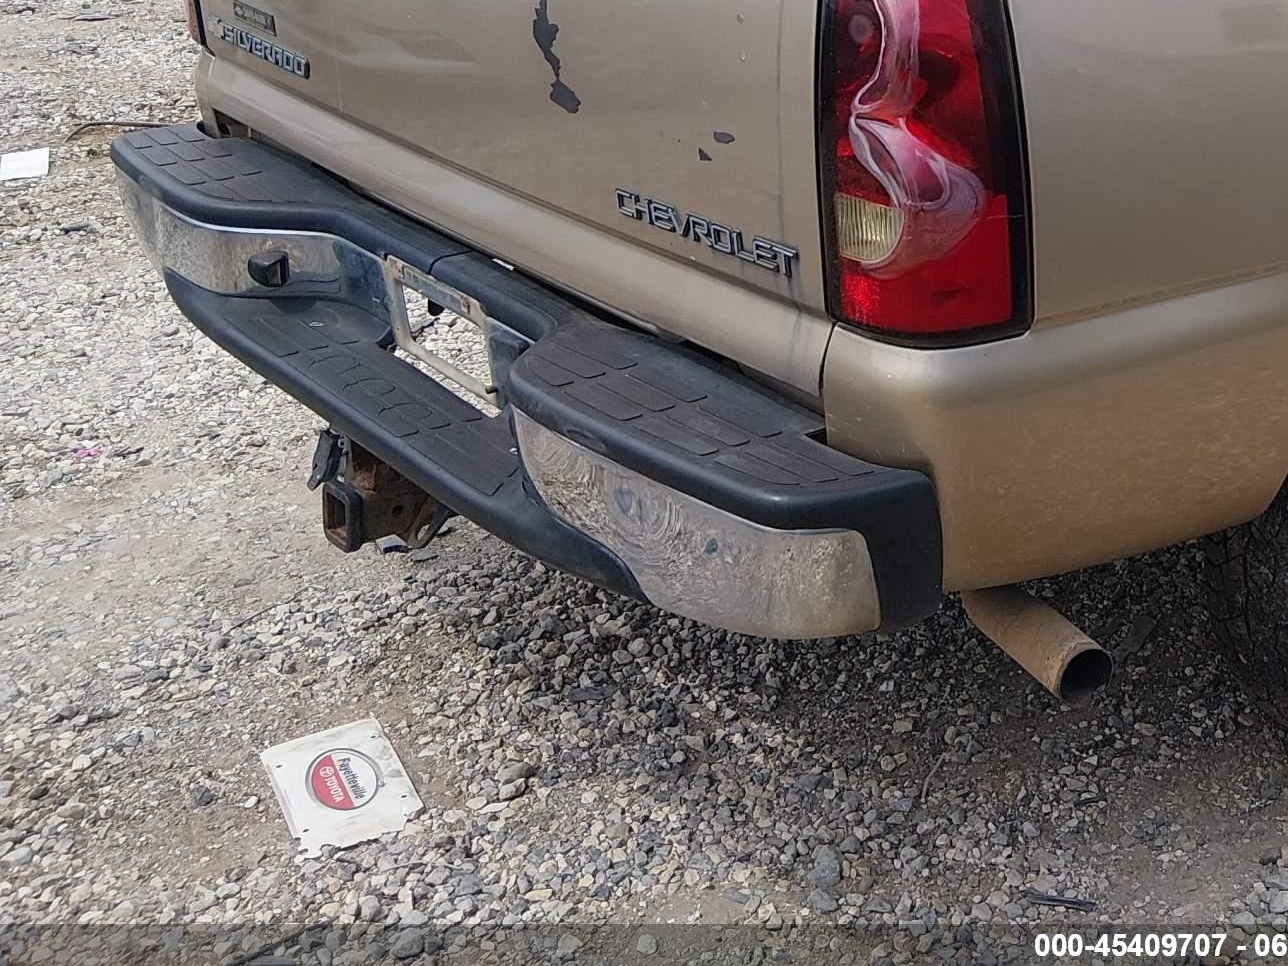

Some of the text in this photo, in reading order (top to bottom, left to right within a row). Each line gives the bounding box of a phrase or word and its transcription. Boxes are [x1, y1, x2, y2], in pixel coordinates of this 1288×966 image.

[223, 24, 306, 77] SILVERADO
[615, 187, 799, 277] CHEVROLET
[324, 775, 345, 803] TOYOTA
[337, 757, 367, 800] Fayetteville
